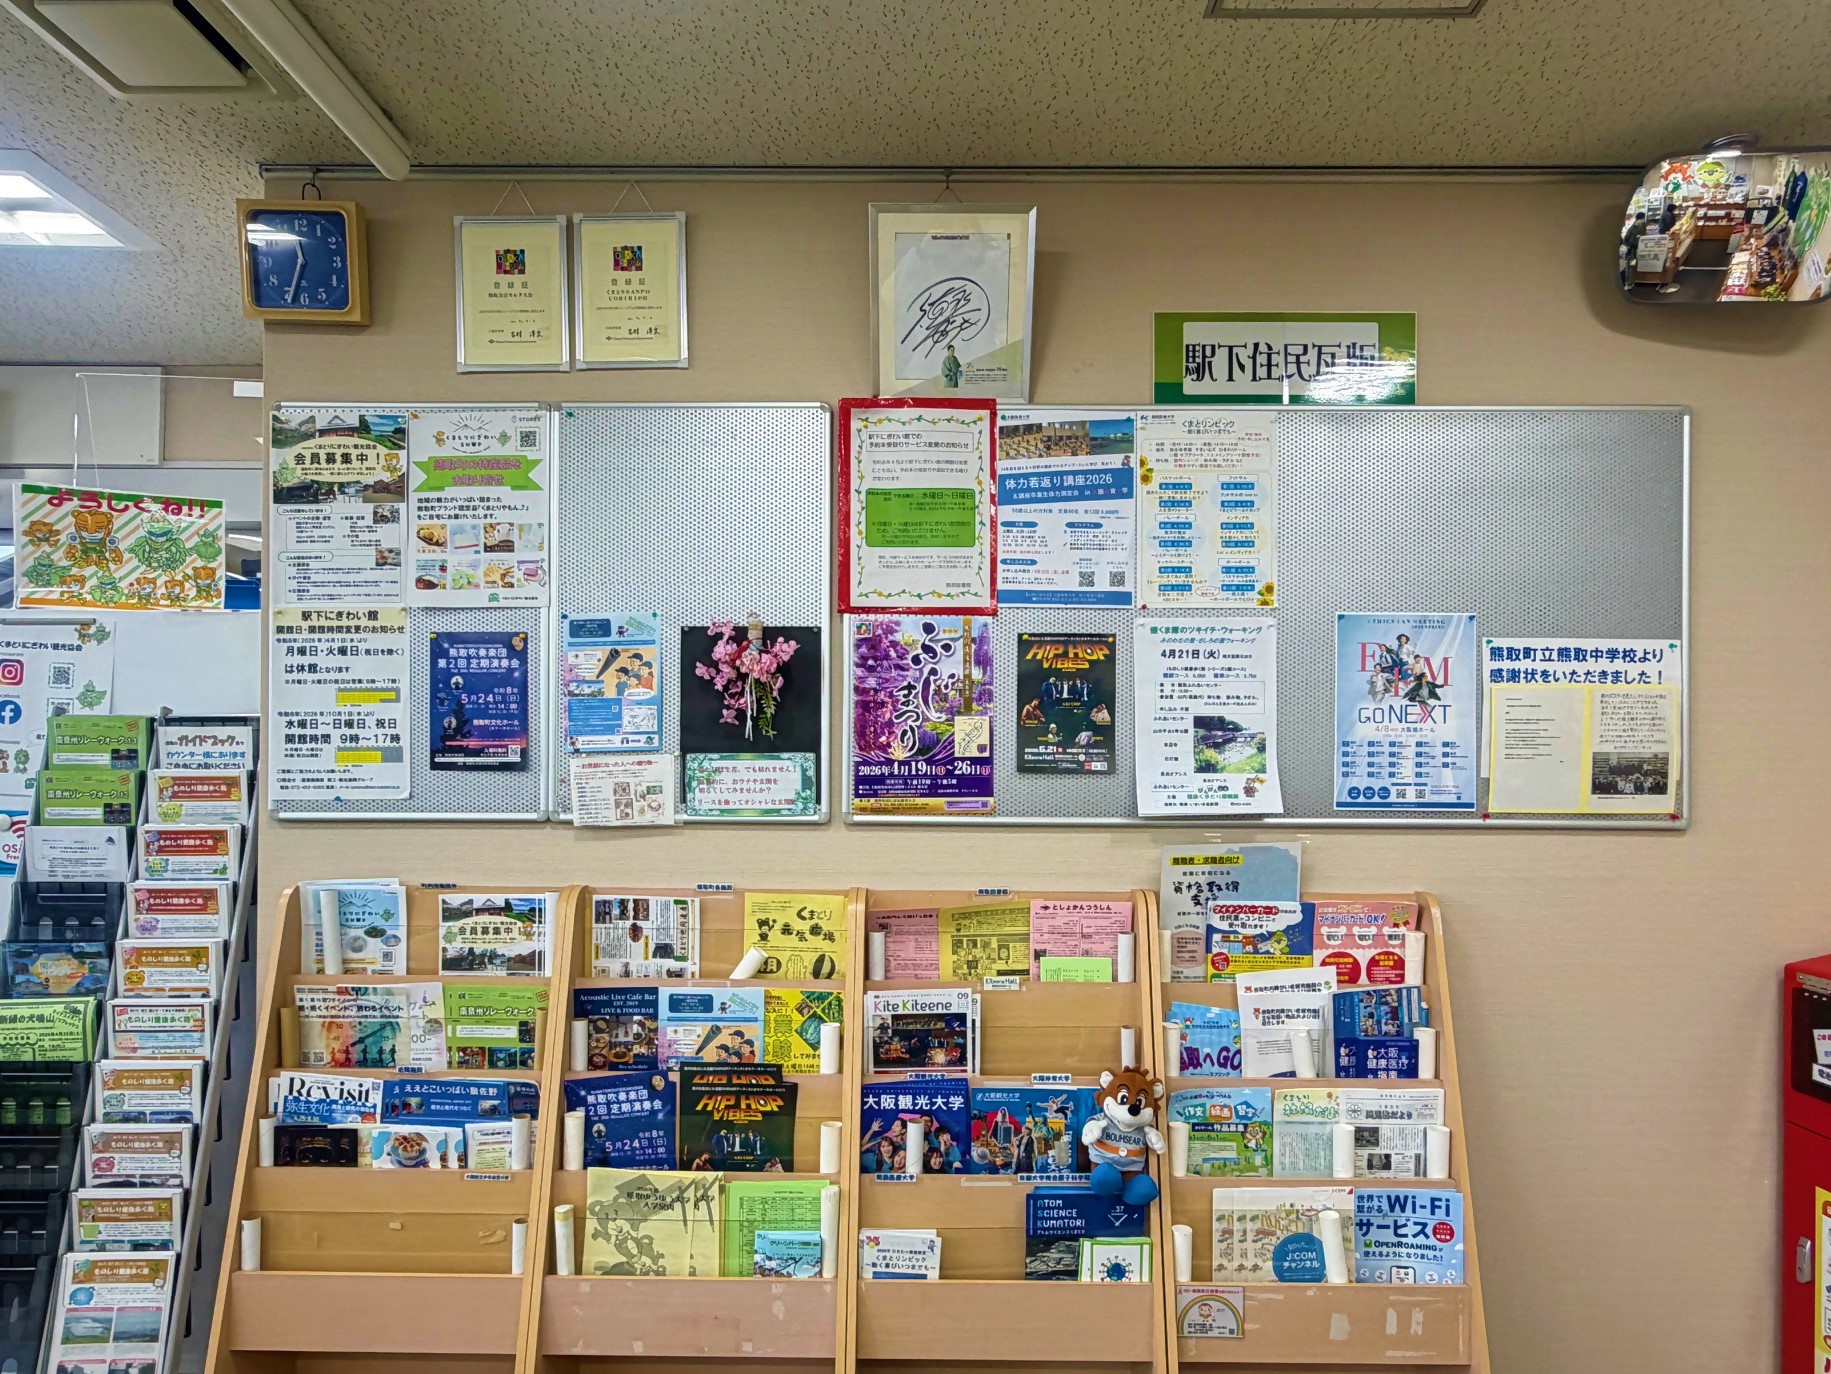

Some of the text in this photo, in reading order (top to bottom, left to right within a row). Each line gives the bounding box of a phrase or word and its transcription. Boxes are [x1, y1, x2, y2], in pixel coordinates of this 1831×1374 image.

[294, 218, 308, 232] 12
[316, 224, 322, 236] 1
[328, 236, 337, 249] 2
[332, 256, 342, 268] 3
[268, 275, 278, 286] 8
[300, 293, 310, 305] 6
[318, 288, 327, 300] 5
[294, 452, 380, 465] 会員募集中！
[1005, 474, 1113, 490] 体力若返り講座2026
[921, 492, 974, 500] 水曜日～日曜日
[48, 488, 207, 519] よろしくね!!
[301, 610, 379, 621] 駅下にぎわい館
[449, 648, 507, 657] 熊取吹奏楽団
[1068, 643, 1110, 660] HOP
[1489, 646, 1664, 663] 熊取町立熊取中学校より
[285, 663, 351, 674] は休館となります
[438, 659, 520, 668] 第2回 定期演奏会
[1042, 658, 1090, 668] VIBES
[1489, 668, 1663, 685] 感謝状をいただきました！
[1358, 704, 1452, 724] GO NEXT
[285, 718, 397, 730] 水曜日～日曜日、祝日
[178, 735, 236, 746] ガイドブック
[285, 734, 331, 744] 開館時間
[1172, 881, 1239, 894] 資格取得
[796, 906, 832, 921] くまとり
[1213, 905, 1280, 915] マイナンバーカード
[458, 926, 522, 936] 会員募集中！
[874, 1000, 952, 1012] Kite Kiteene
[1378, 1047, 1398, 1058] 大阪
[404, 1085, 498, 1096] ええとこいっぱい泉佐野
[587, 1090, 648, 1104] 熊取吹奏楽団
[741, 1095, 784, 1111] HOP
[863, 1094, 965, 1110] 大阪観光大学
[610, 1099, 662, 1114] 定期演奏会
[1185, 1105, 1255, 1117] 作文 絵画 習字
[714, 1109, 762, 1120] VIBES
[1357, 1194, 1450, 1217] 世界で Wi-Fi
[1357, 1205, 1384, 1214] 繋がる
[1038, 1209, 1077, 1217] SCIENCE
[1038, 1219, 1085, 1227] KUMATORI
[1356, 1219, 1430, 1240] サービス
[1286, 1252, 1316, 1260] J:COM
[1364, 1251, 1443, 1262] 使えるようになりました！
